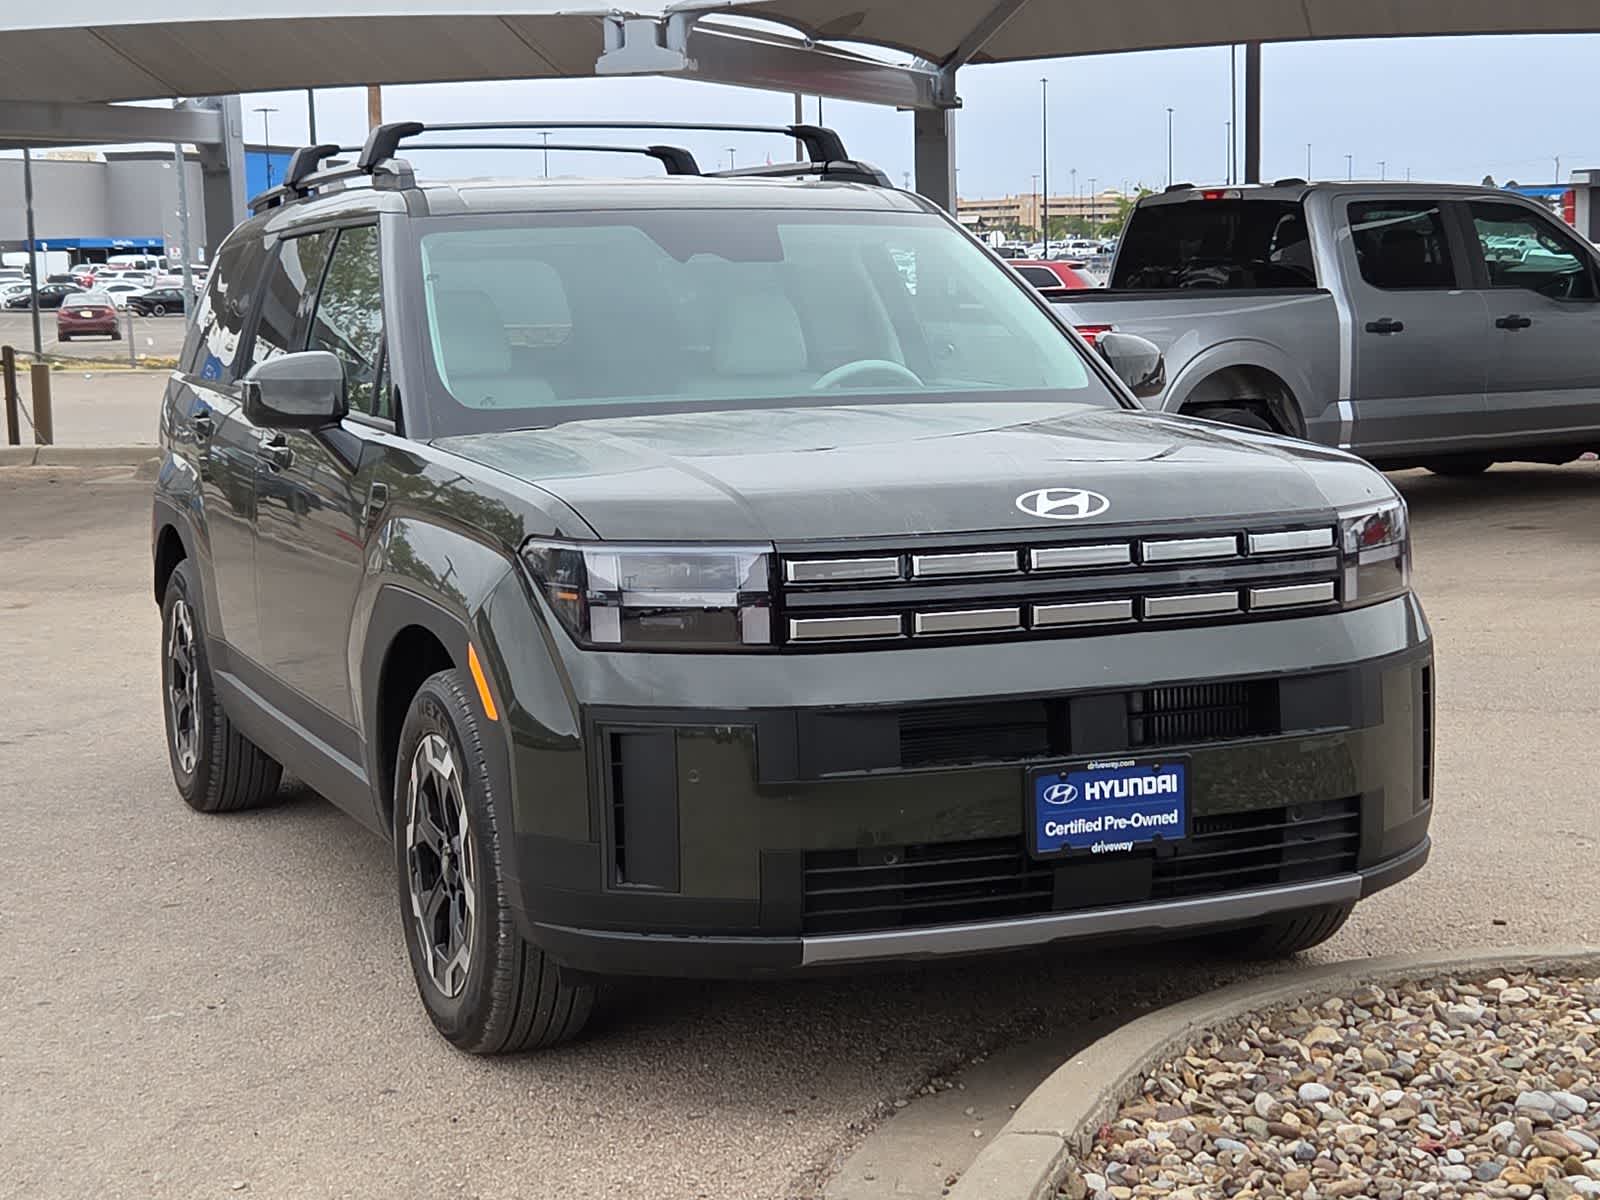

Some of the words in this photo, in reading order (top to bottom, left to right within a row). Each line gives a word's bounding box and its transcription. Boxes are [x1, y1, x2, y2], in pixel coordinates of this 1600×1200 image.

[1087, 759, 1135, 770] driveway.com
[1085, 774, 1178, 800] HYUNDAI
[1045, 817, 1102, 837] Certified
[1104, 809, 1178, 831] Pre-Owned
[1091, 840, 1133, 854] driveway
